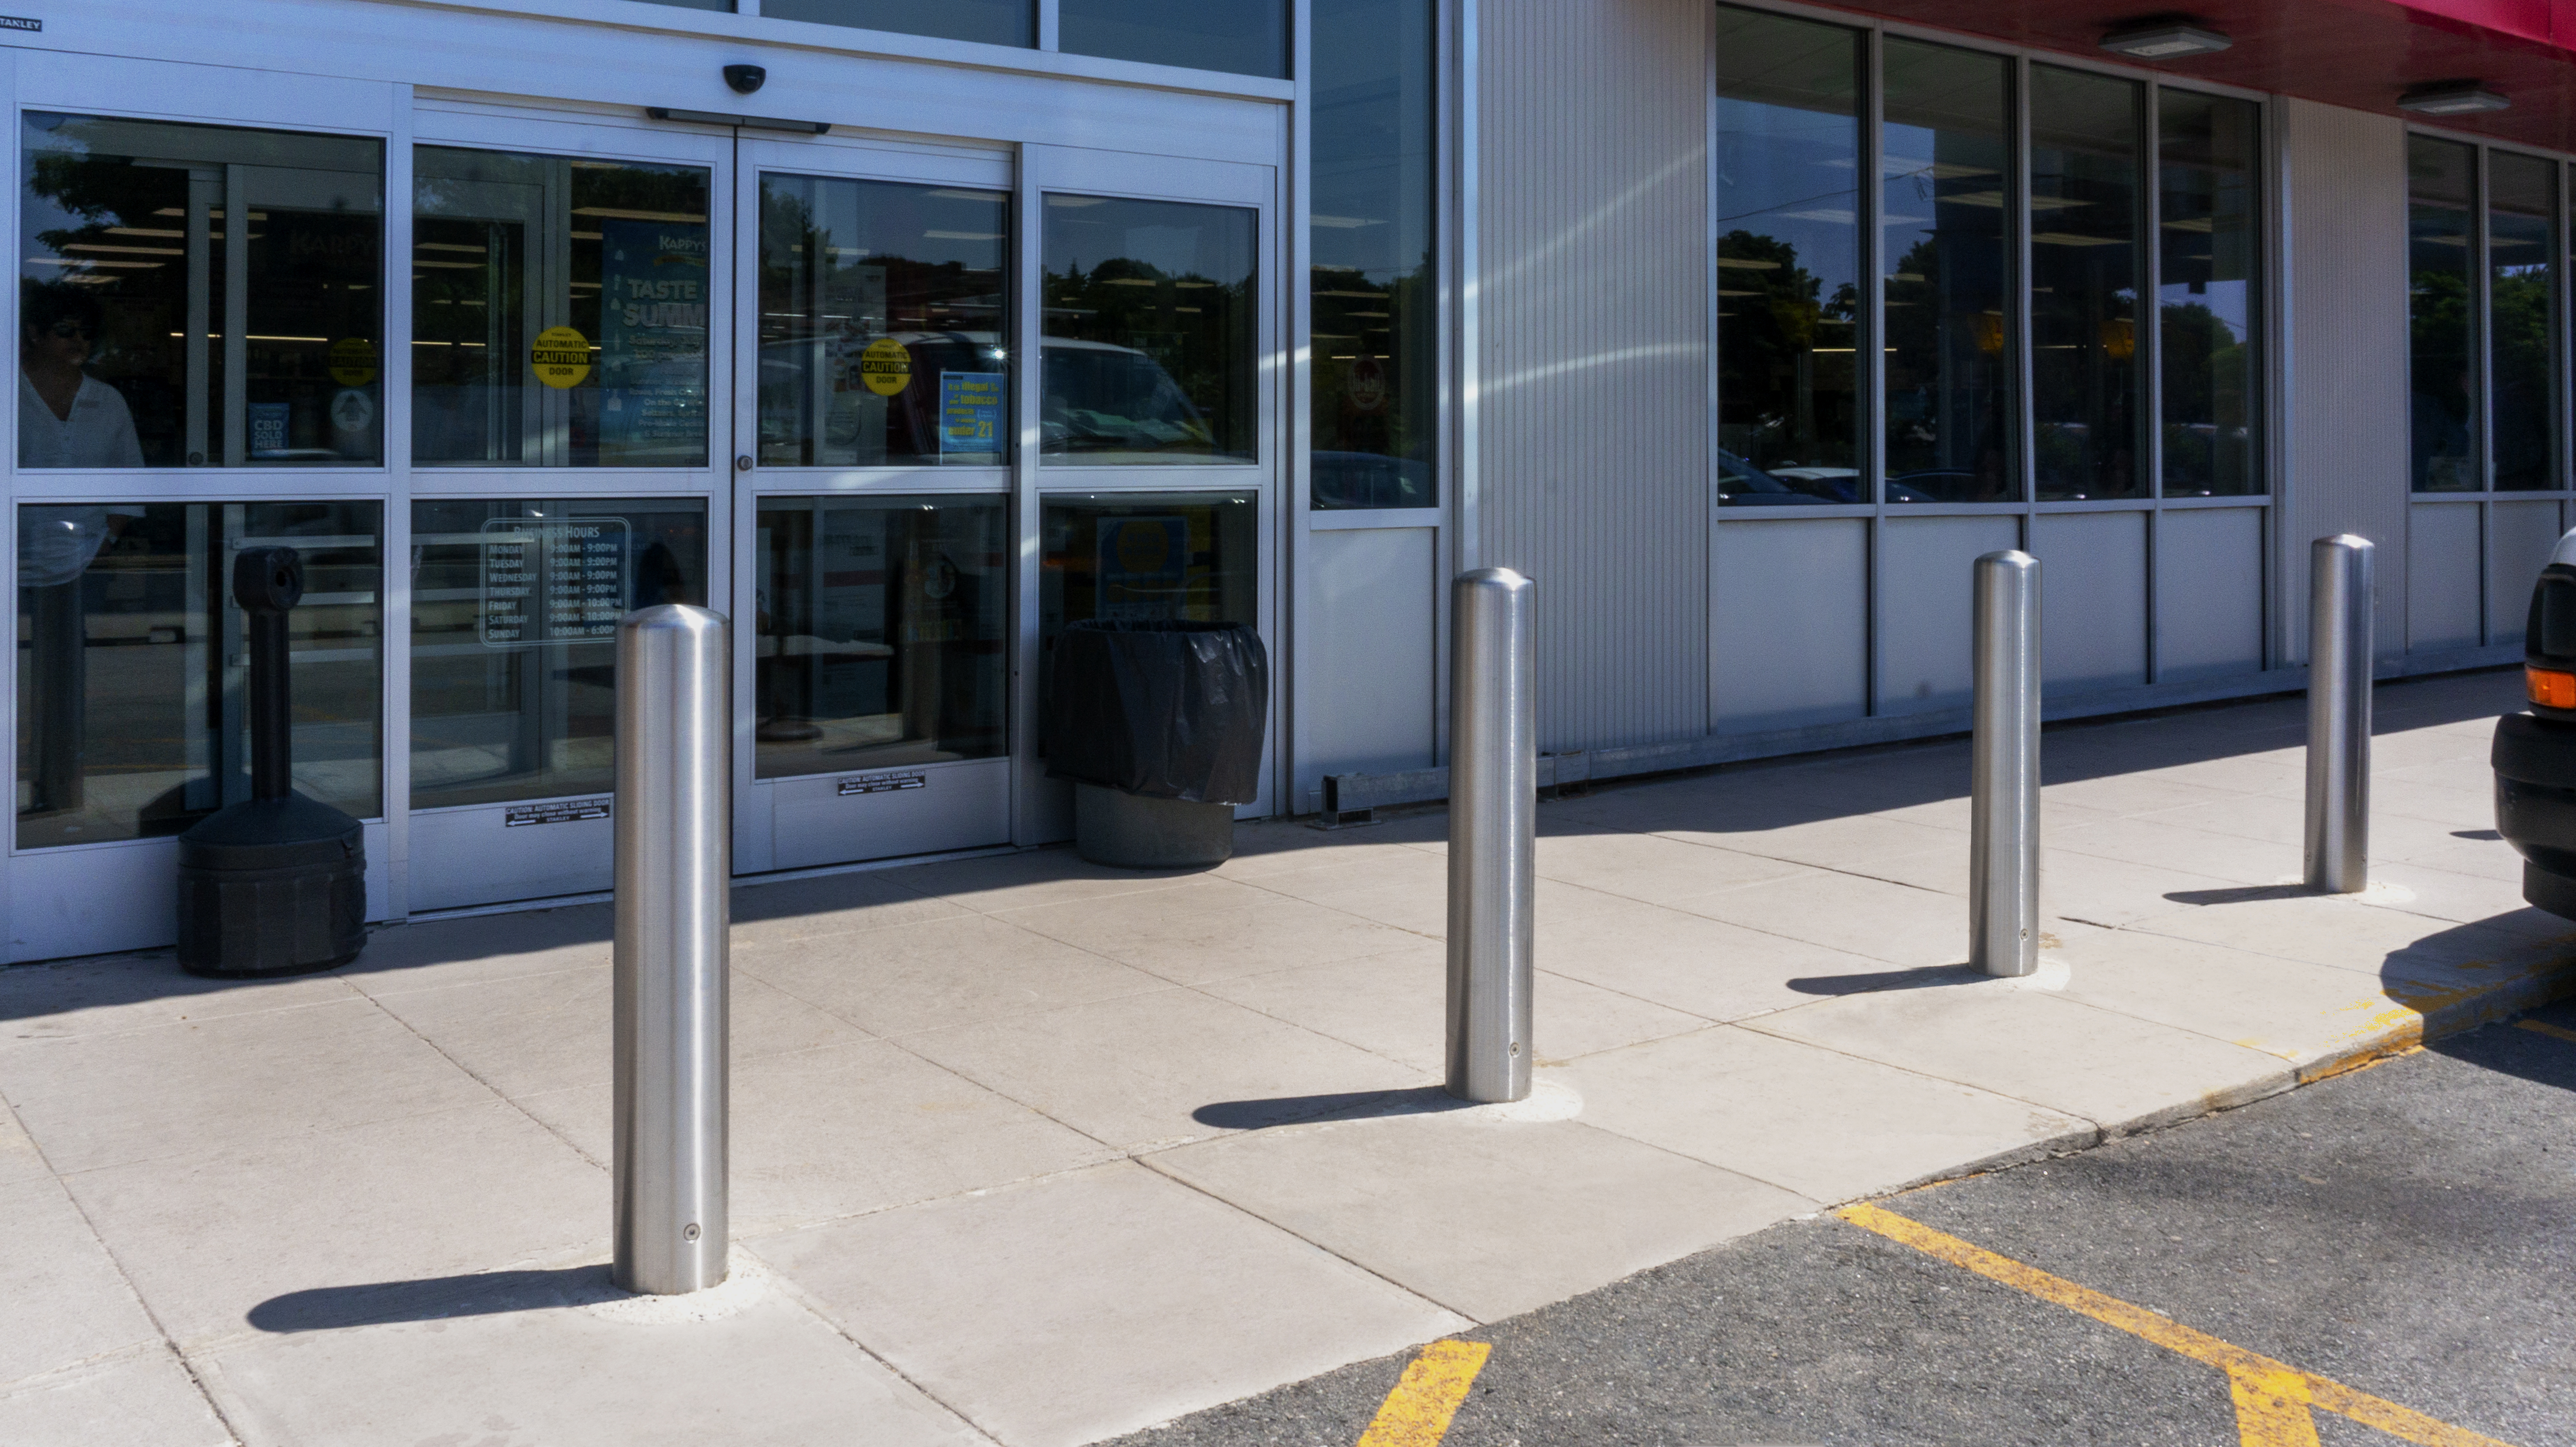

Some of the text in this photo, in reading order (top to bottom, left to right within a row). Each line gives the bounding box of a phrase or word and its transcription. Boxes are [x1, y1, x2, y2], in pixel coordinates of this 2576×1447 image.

[0, 18, 40, 29] TANLEY
[627, 278, 697, 300] TASTE
[622, 303, 705, 328] SUMM
[536, 339, 586, 349] AUTOMATIC
[533, 351, 588, 363] CAUTION
[549, 367, 574, 375] DOOR
[863, 362, 909, 372] CAUTION
[962, 382, 988, 392] illegal
[961, 394, 997, 405] tobacco
[254, 420, 283, 430] CBD
[948, 425, 975, 436] under
[979, 420, 993, 437] 21
[254, 430, 283, 439] SOLD
[254, 439, 283, 448] HERE
[565, 526, 600, 538] HOURS
[488, 545, 523, 554] MONDAY
[586, 543, 617, 553] 9:00PM
[489, 559, 524, 568] TUESDAY
[586, 557, 617, 566] 9:00PM
[489, 573, 537, 582] WEDNESDAY
[586, 570, 617, 580] 9:00PM
[489, 587, 530, 596] THURSDAY
[586, 584, 617, 593] 9:00PM
[489, 601, 517, 610] FRIDAY
[587, 598, 622, 607] 10:00PM
[488, 614, 529, 624] SATURDAY
[587, 611, 621, 621] 10:00PM
[488, 629, 521, 639] SUNDAY
[591, 625, 615, 634] 6:00P
[534, 803, 568, 812] AUTOMATIC
[570, 801, 593, 809] SLIDING
